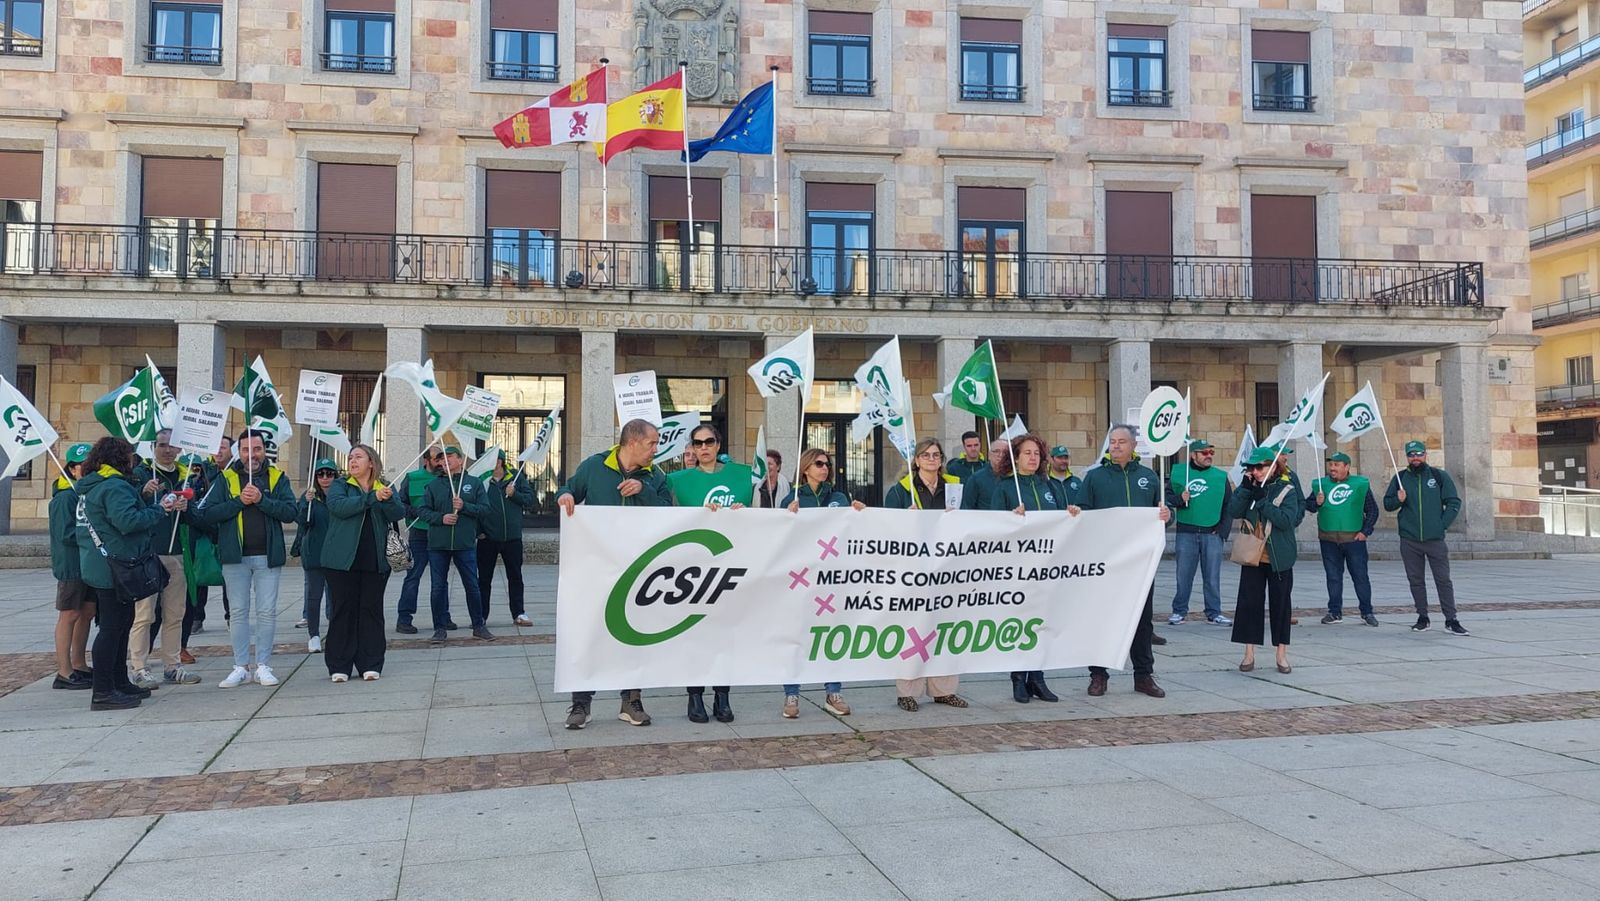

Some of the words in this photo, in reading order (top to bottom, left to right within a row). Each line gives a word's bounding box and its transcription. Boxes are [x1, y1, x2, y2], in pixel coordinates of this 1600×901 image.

[505, 309, 694, 329] SUBDELEGACION
[708, 315, 749, 330] DEL
[757, 315, 869, 332] GOBIERNO
[122, 398, 148, 427] CSIF
[1155, 412, 1181, 428] CSIF
[658, 428, 686, 445] SIF
[1333, 489, 1354, 498] CSIF
[934, 539, 1012, 557] SALARIAL
[1016, 539, 1054, 554] YA!!!
[816, 569, 896, 585] MEJORES
[901, 566, 1013, 587] CONDICIONES
[1017, 562, 1106, 581] LABORALES
[635, 566, 748, 607] CSIF
[844, 591, 884, 611] MÁS
[889, 595, 953, 612] EMPLEO
[957, 589, 1025, 607] PÚBLICO
